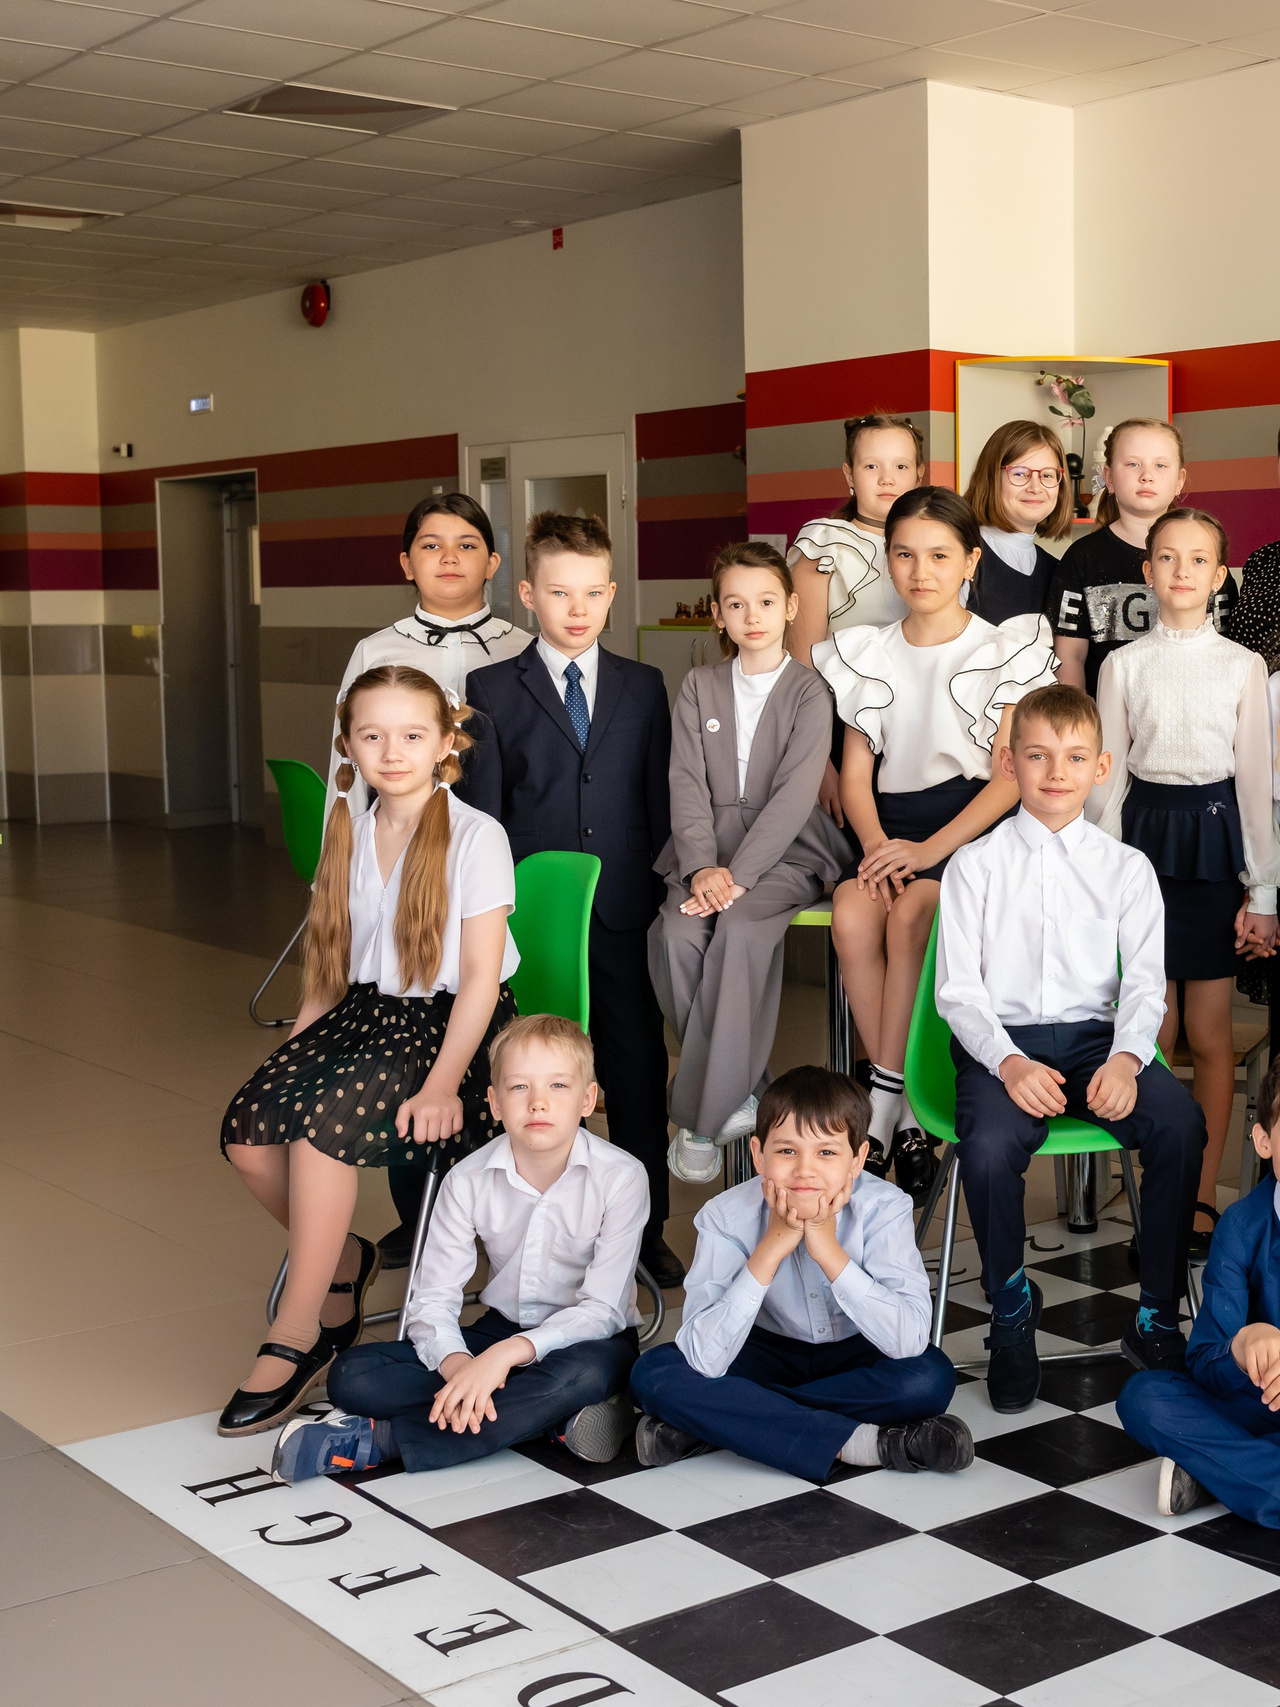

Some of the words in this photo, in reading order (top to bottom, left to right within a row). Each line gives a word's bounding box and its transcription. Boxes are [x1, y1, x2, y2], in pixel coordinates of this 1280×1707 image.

[250, 1511, 353, 1546] G
[328, 1563, 441, 1600] F
[413, 1608, 533, 1658] E
